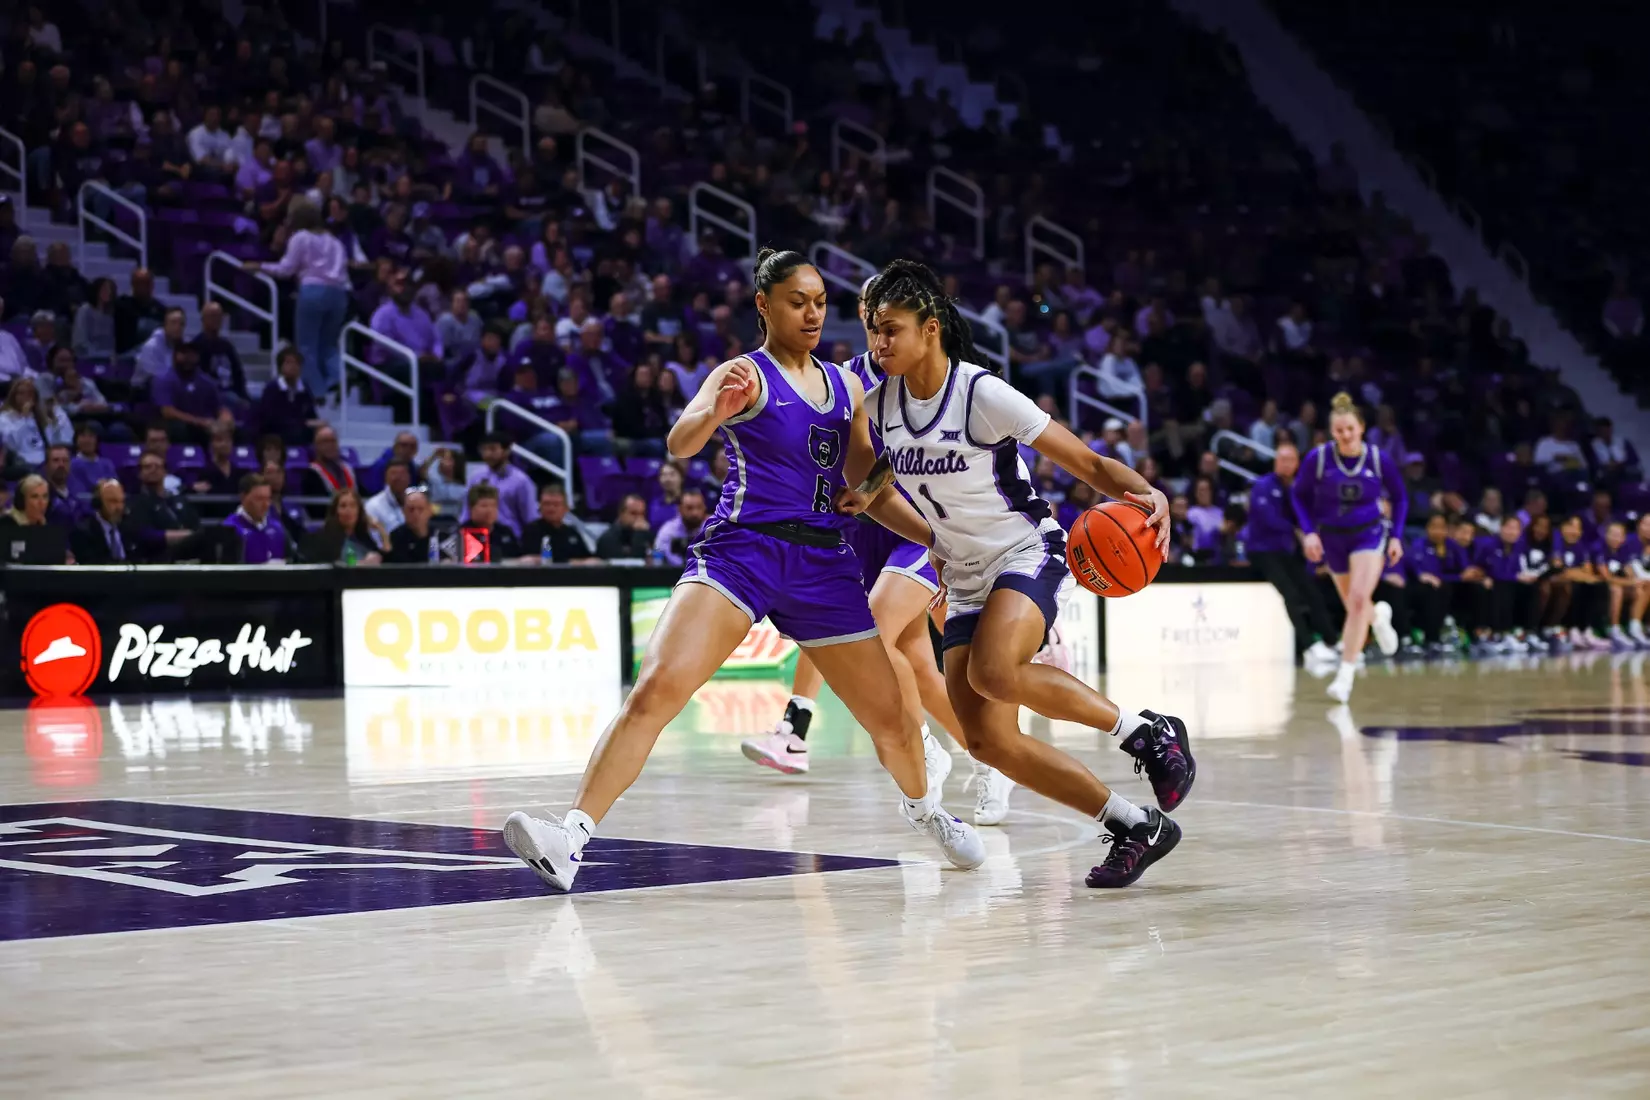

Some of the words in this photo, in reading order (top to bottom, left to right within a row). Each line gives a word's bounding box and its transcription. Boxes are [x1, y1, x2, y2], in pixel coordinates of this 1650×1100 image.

[886, 446, 970, 476] Wildcats
[917, 482, 950, 520] 1
[108, 622, 225, 683] Pizza
[226, 622, 312, 676] Hut
[364, 608, 599, 672] QDOBA
